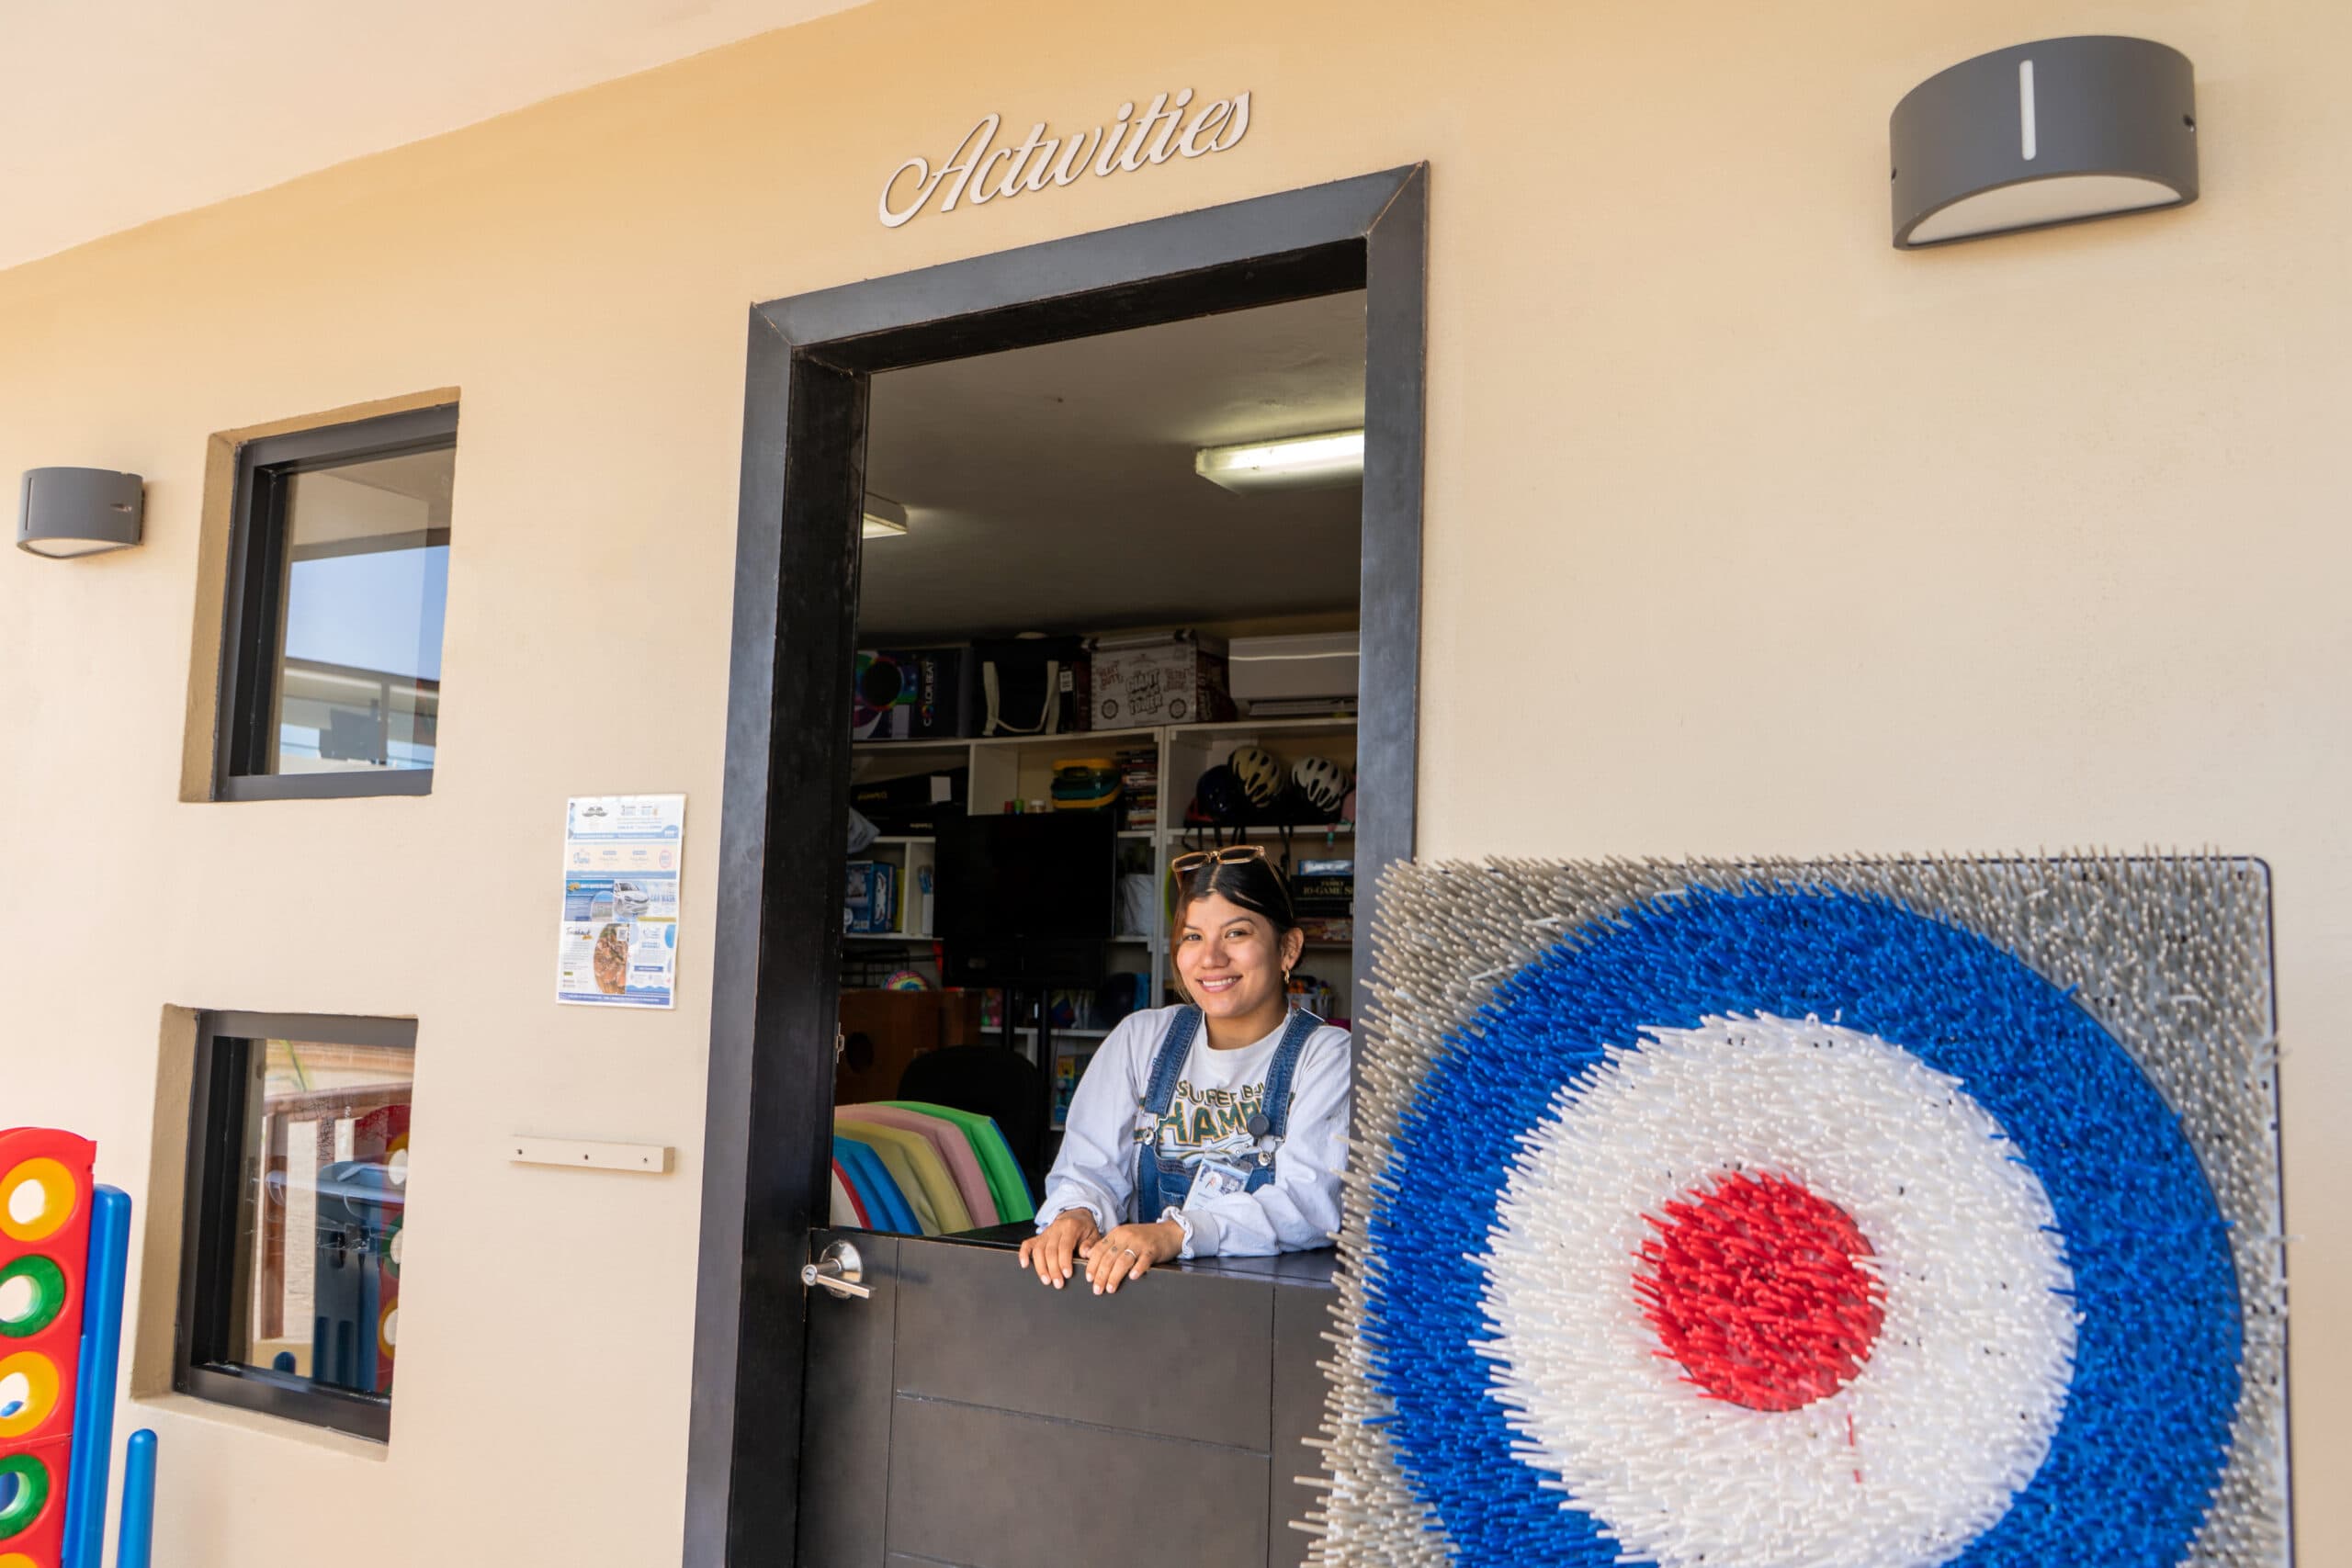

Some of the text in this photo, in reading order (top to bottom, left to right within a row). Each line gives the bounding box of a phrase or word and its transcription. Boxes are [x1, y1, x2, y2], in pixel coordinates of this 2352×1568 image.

[877, 88, 1251, 229] Activities
[1125, 669, 1160, 694] GIANT
[1128, 694, 1162, 715] TOWER
